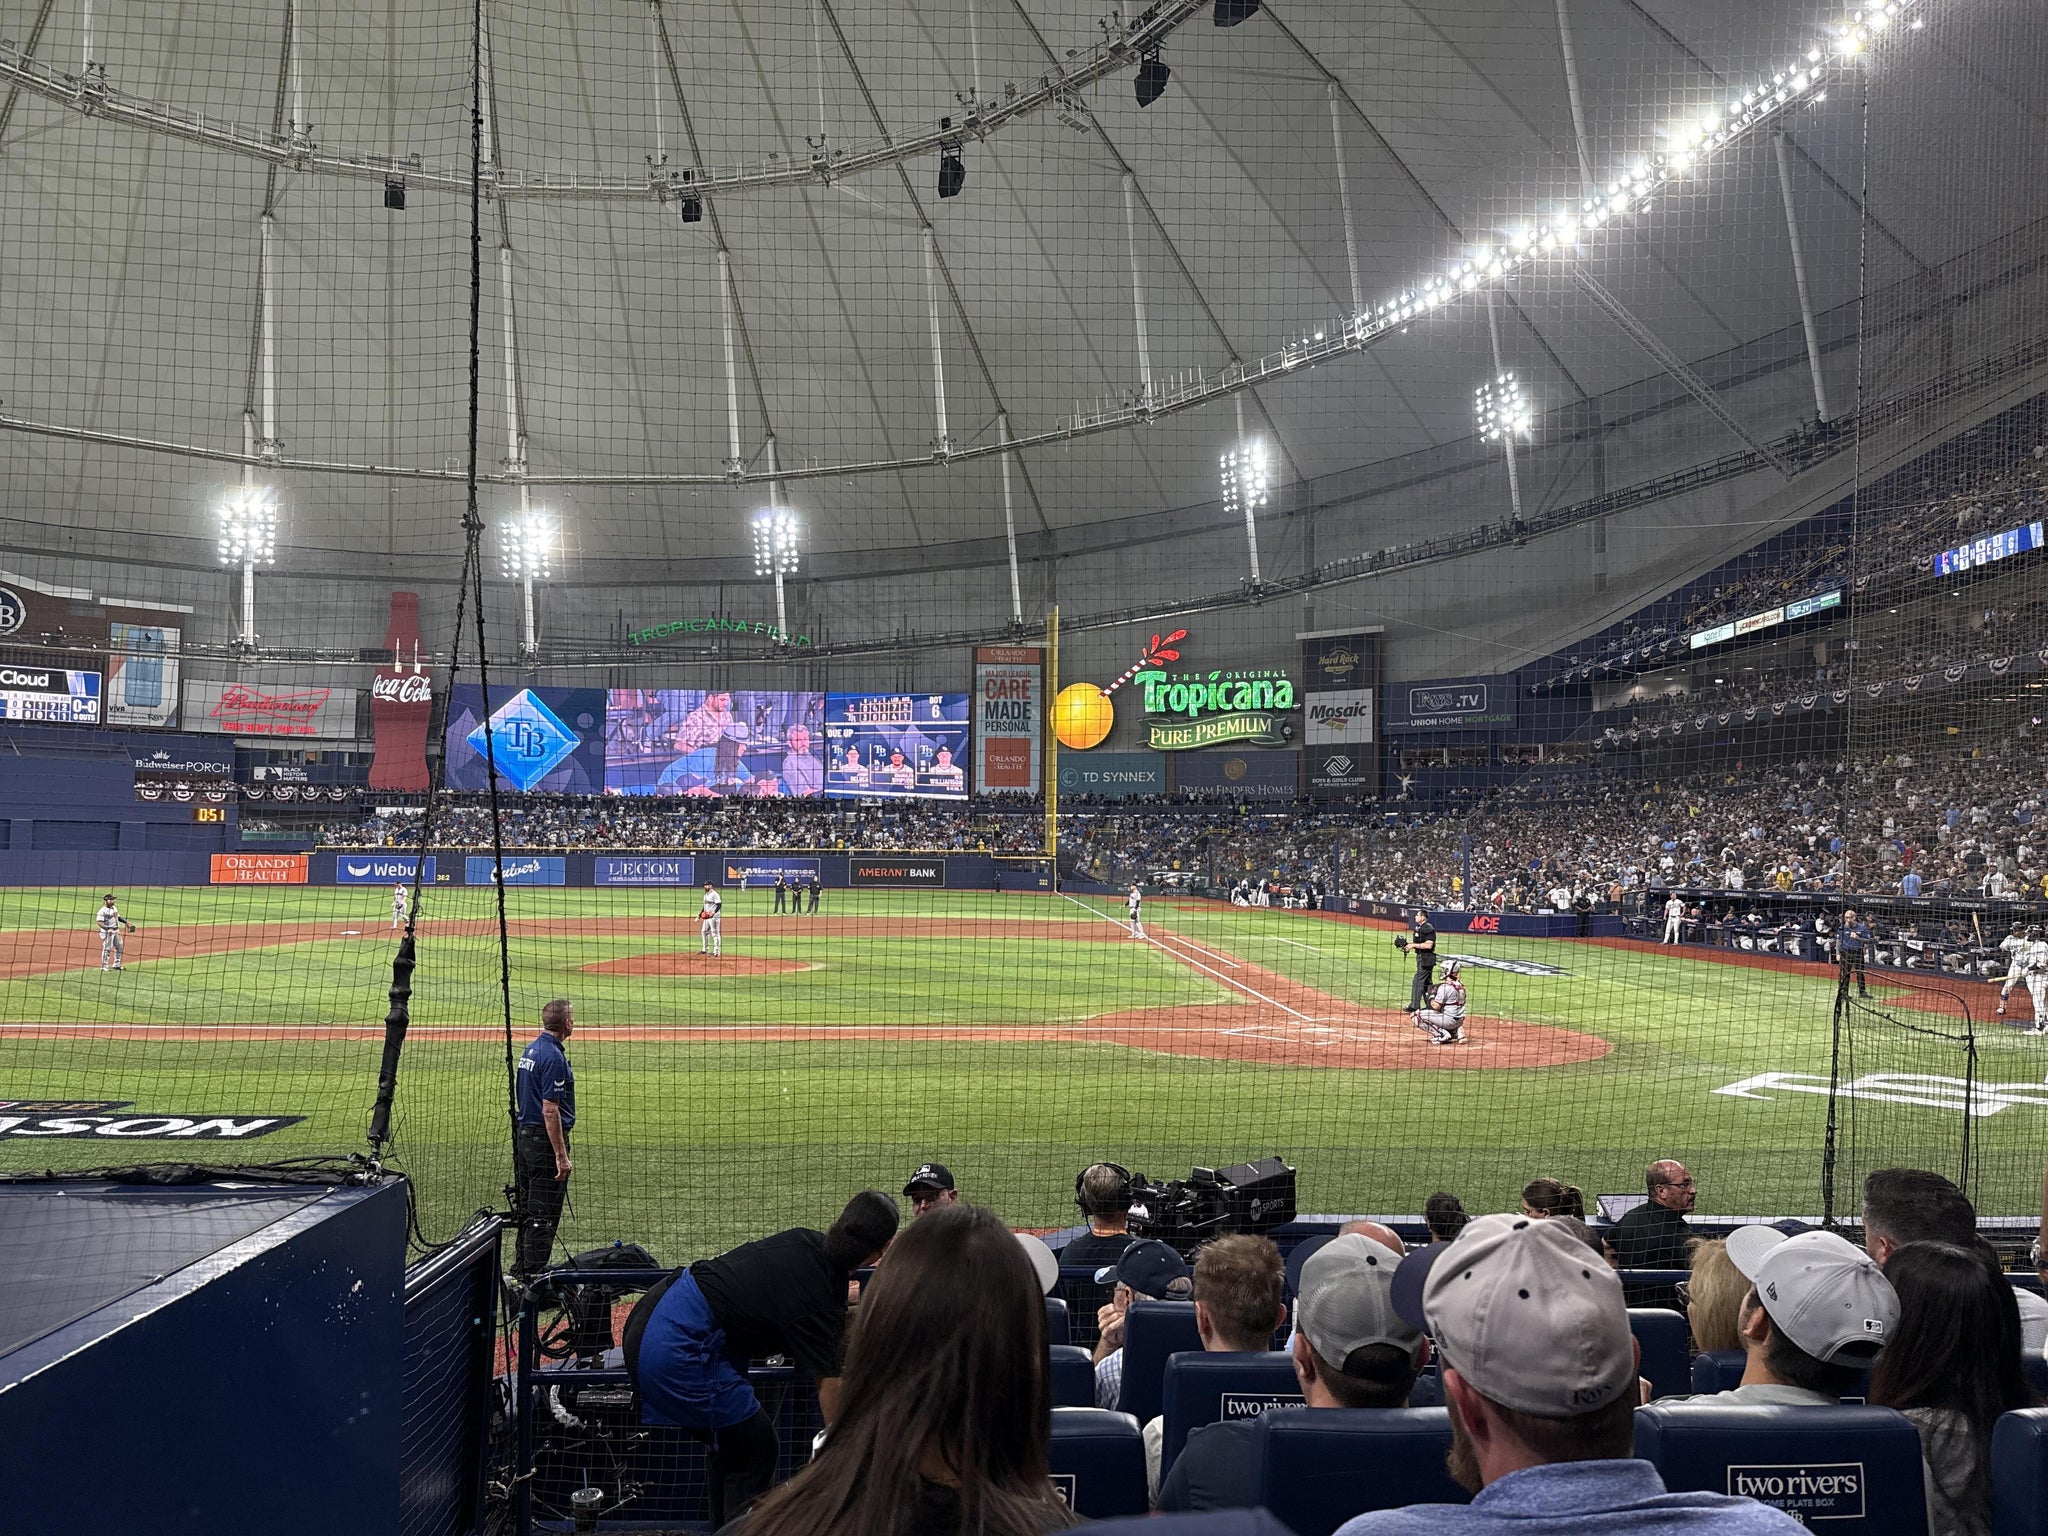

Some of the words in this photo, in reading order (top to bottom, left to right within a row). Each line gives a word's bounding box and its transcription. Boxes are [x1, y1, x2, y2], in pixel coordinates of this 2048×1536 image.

[628, 618, 748, 646] TROPICANA
[990, 648, 1026, 656] ORLANDO
[1318, 654, 1339, 666] Hard
[1340, 653, 1360, 664] Rock
[0, 670, 49, 687] Cloud
[1226, 670, 1286, 679] ORIGINAL
[372, 674, 432, 702] Coca-Cola
[985, 679, 1032, 700] CARE
[1134, 670, 1294, 717] Tropicana
[223, 692, 320, 712] Budweiser
[931, 704, 941, 718] 6
[985, 701, 1032, 720] MADE
[1310, 702, 1368, 720] Mosaic
[985, 720, 1031, 732] PERSONAL
[1439, 716, 1463, 725] HOME
[1464, 714, 1511, 724] MORTGAGE
[222, 722, 243, 732] THIS
[276, 725, 294, 734] FOR
[828, 729, 843, 738] DUE
[844, 729, 854, 738] UP
[1150, 727, 1192, 744] PURE
[1196, 718, 1272, 742] PREMIUM
[989, 754, 1026, 762] ORLANDO
[135, 760, 186, 770] Budweiser
[186, 762, 230, 773] PORCH
[1082, 772, 1099, 782] TD
[1102, 772, 1156, 782] SYNNEX
[1179, 784, 1214, 795] DREAM
[1216, 784, 1255, 795] FINDERS
[1258, 784, 1294, 795] HOMES
[199, 808, 224, 822] 0:51
[226, 858, 295, 869] ORLANDO
[374, 862, 426, 877] Webul
[233, 869, 290, 881] HEALTH
[858, 868, 908, 877] AMERANT
[909, 868, 936, 877] BANK
[1468, 914, 1500, 930] ACE
[1262, 1198, 1284, 1212] SPORTS
[1228, 1398, 1261, 1414] two
[1736, 1472, 1784, 1495] two
[1786, 1470, 1858, 1495] rivers
[1786, 1498, 1813, 1507] PLATE
[1815, 1498, 1835, 1506] BOX
